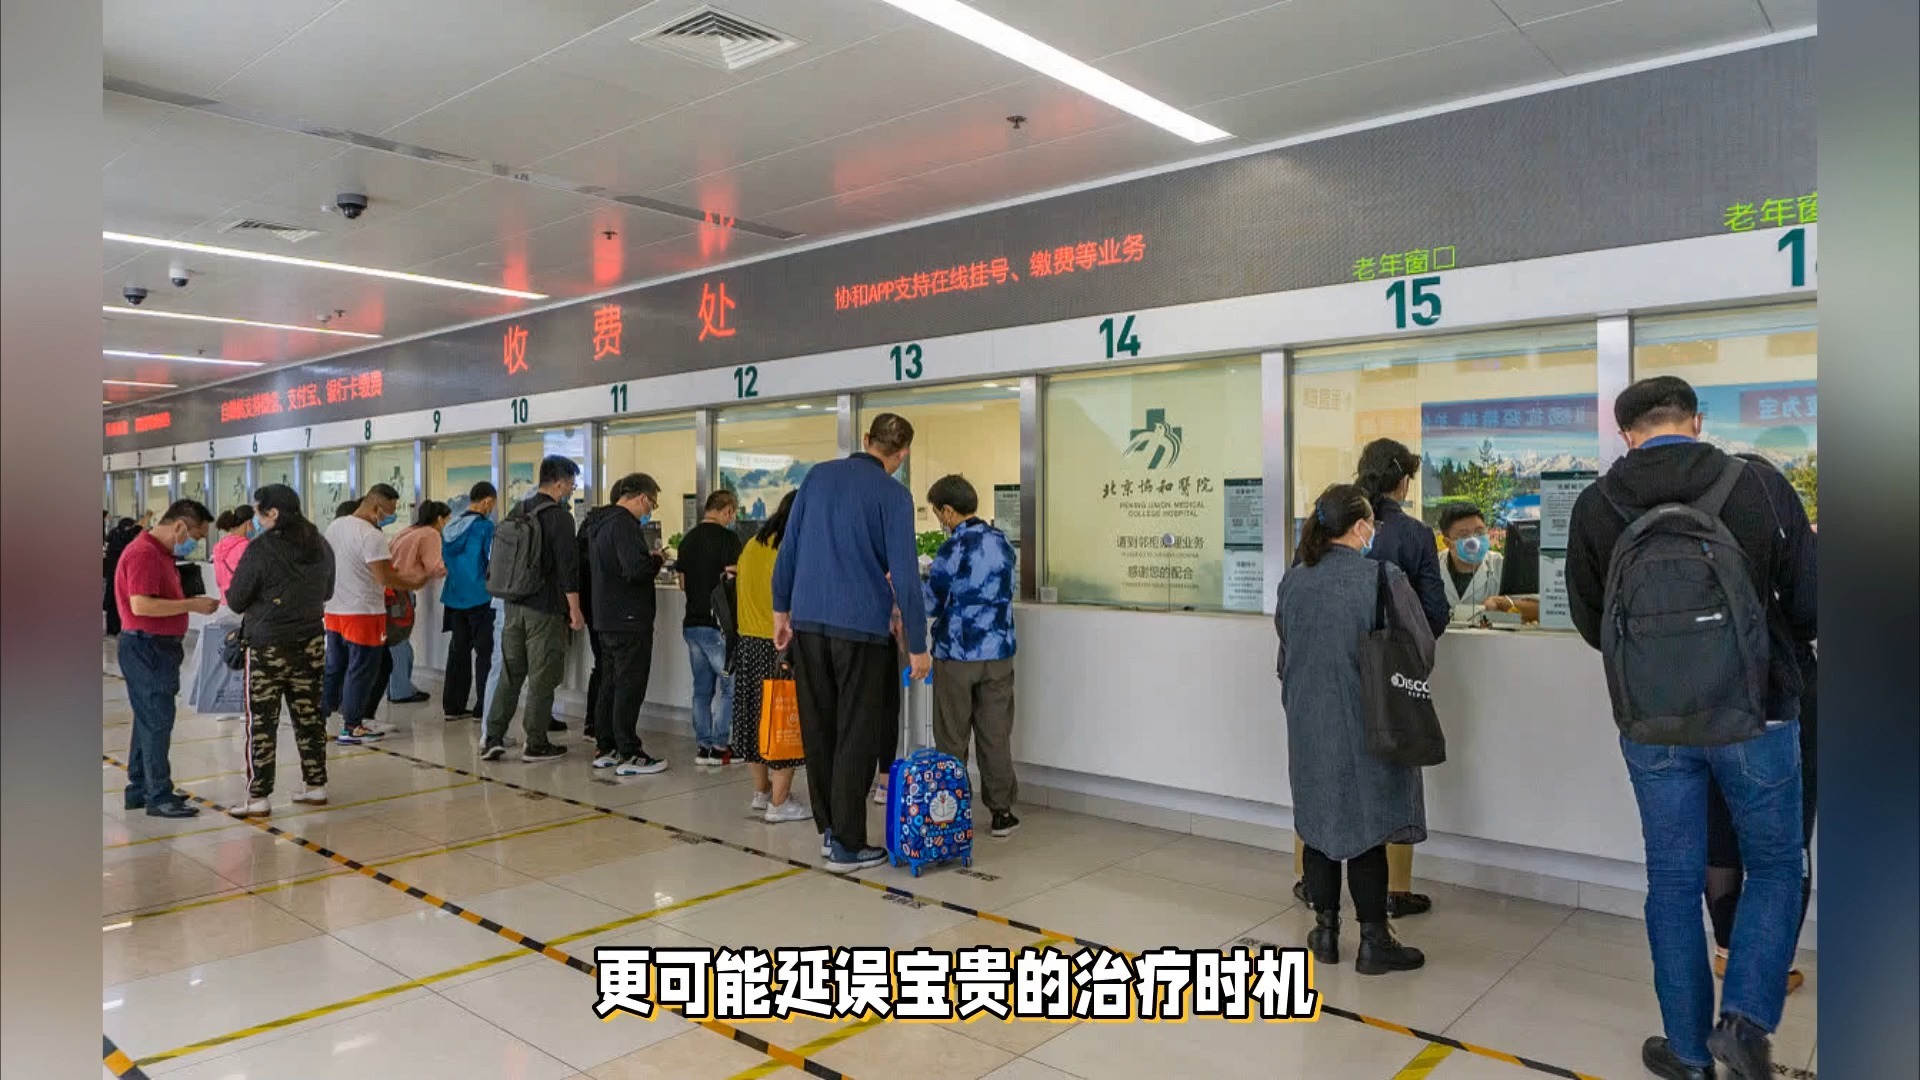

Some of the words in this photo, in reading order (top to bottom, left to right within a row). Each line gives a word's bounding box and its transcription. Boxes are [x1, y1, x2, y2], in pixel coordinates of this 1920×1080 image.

[1352, 246, 1455, 280] 老年窗口
[1777, 227, 1818, 287] 1
[835, 234, 1146, 310] 协和APP支持在线挂号、缴费等业务
[1385, 276, 1442, 330] 15
[1099, 315, 1141, 359] 14
[889, 343, 923, 381] 13
[733, 365, 759, 398] 12
[510, 397, 528, 424] 10
[610, 383, 628, 413] 11
[364, 419, 372, 441] 8
[433, 410, 441, 433] 9
[209, 441, 215, 458] 5
[252, 434, 258, 452] 6
[305, 427, 312, 447] 7
[1128, 510, 1160, 518] COLLEGE
[1162, 510, 1199, 518] HOSPITAL
[1148, 501, 1171, 509] UNION
[1173, 501, 1205, 509] MEDICAL
[1117, 535, 1205, 549] 请到邻柜理业务
